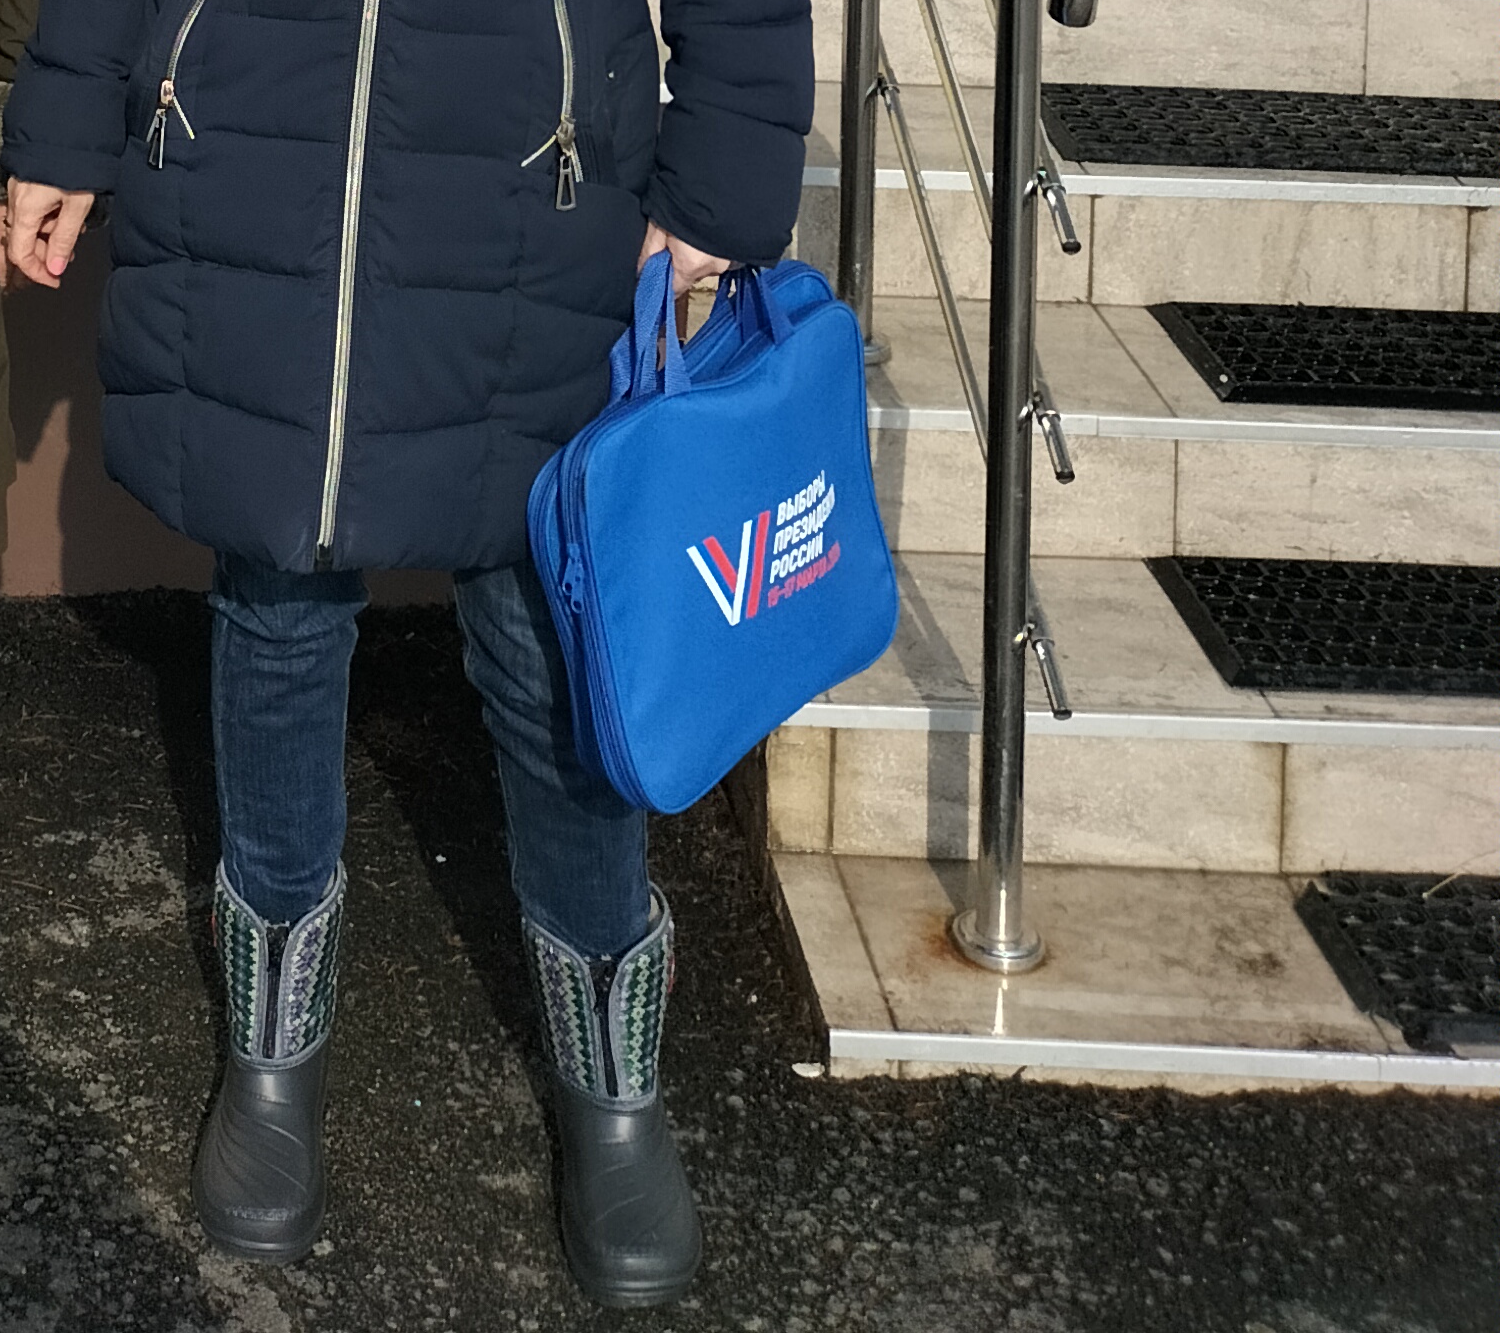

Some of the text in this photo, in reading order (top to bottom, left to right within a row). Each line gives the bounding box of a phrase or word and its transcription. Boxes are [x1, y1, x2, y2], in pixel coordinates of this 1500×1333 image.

[773, 483, 836, 555] ПРЕЗИДЕ
[776, 469, 825, 526] ВЫБОРЫ
[769, 532, 824, 584] РОССИИ
